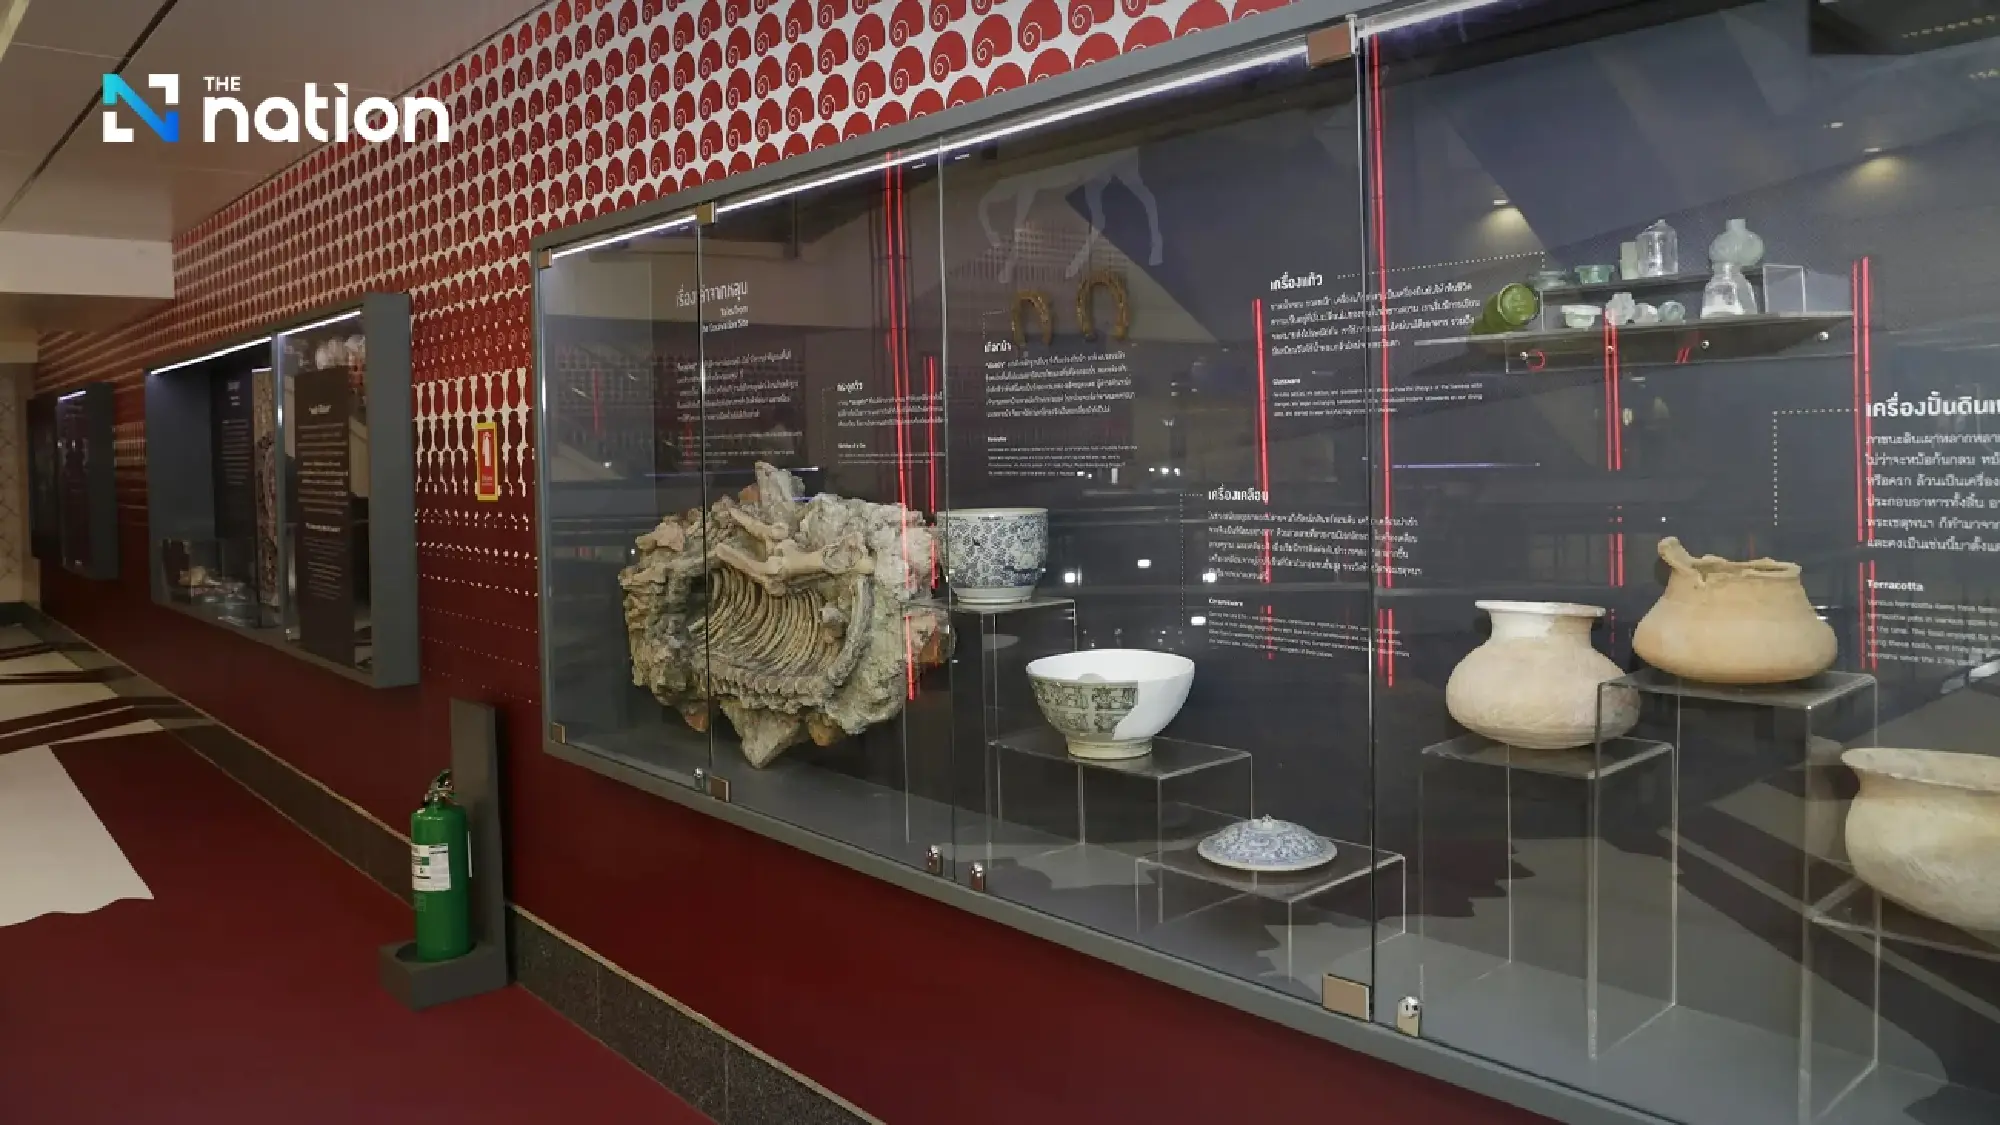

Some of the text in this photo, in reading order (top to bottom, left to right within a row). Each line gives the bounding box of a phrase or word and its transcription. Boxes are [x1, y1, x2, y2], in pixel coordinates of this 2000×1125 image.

[676, 281, 748, 306] เรื่องล่าจากหลุม
[1866, 391, 2000, 417] เครื่องปั้นดินเ
[1867, 579, 1924, 592] Terracotta
